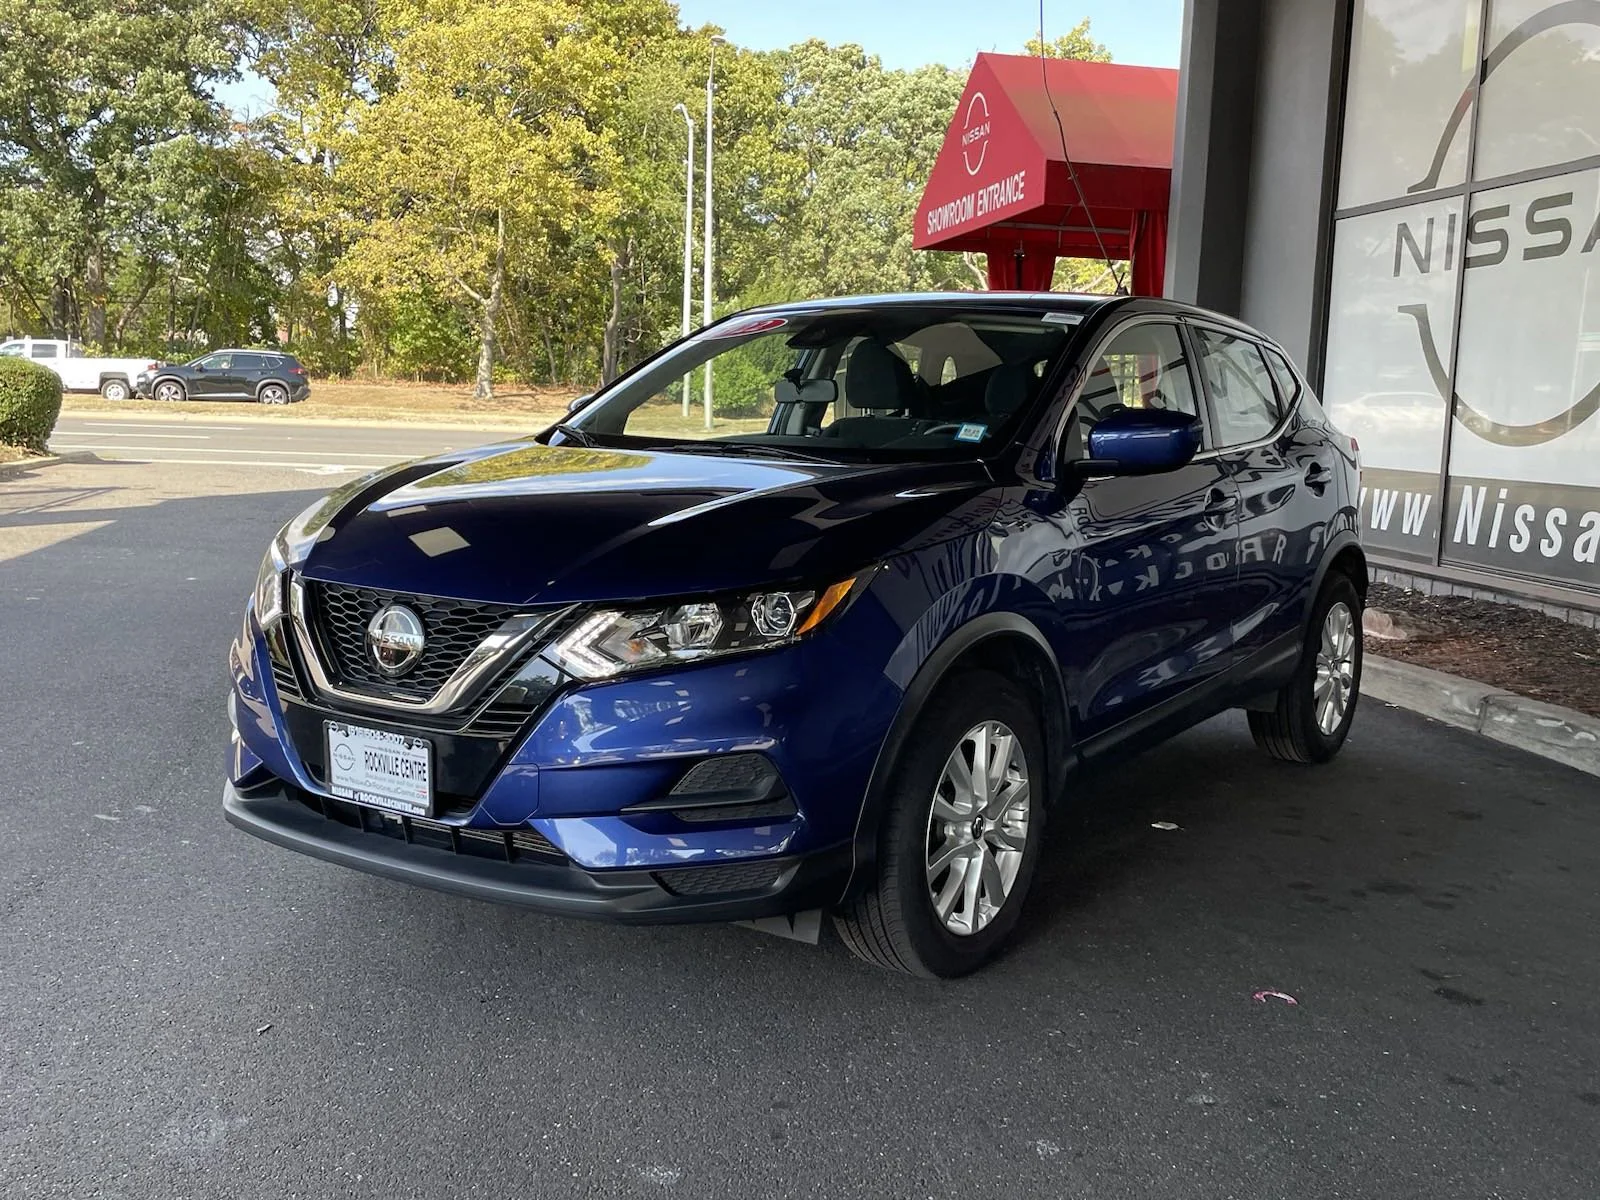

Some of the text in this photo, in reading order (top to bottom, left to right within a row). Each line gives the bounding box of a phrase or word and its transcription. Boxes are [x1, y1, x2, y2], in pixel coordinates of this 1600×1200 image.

[961, 121, 991, 147] NISSAN
[927, 170, 1026, 235] SHOWROOM ENTRANCE
[364, 751, 400, 777] ROCKVILLE
[400, 757, 427, 782] CENTRE
